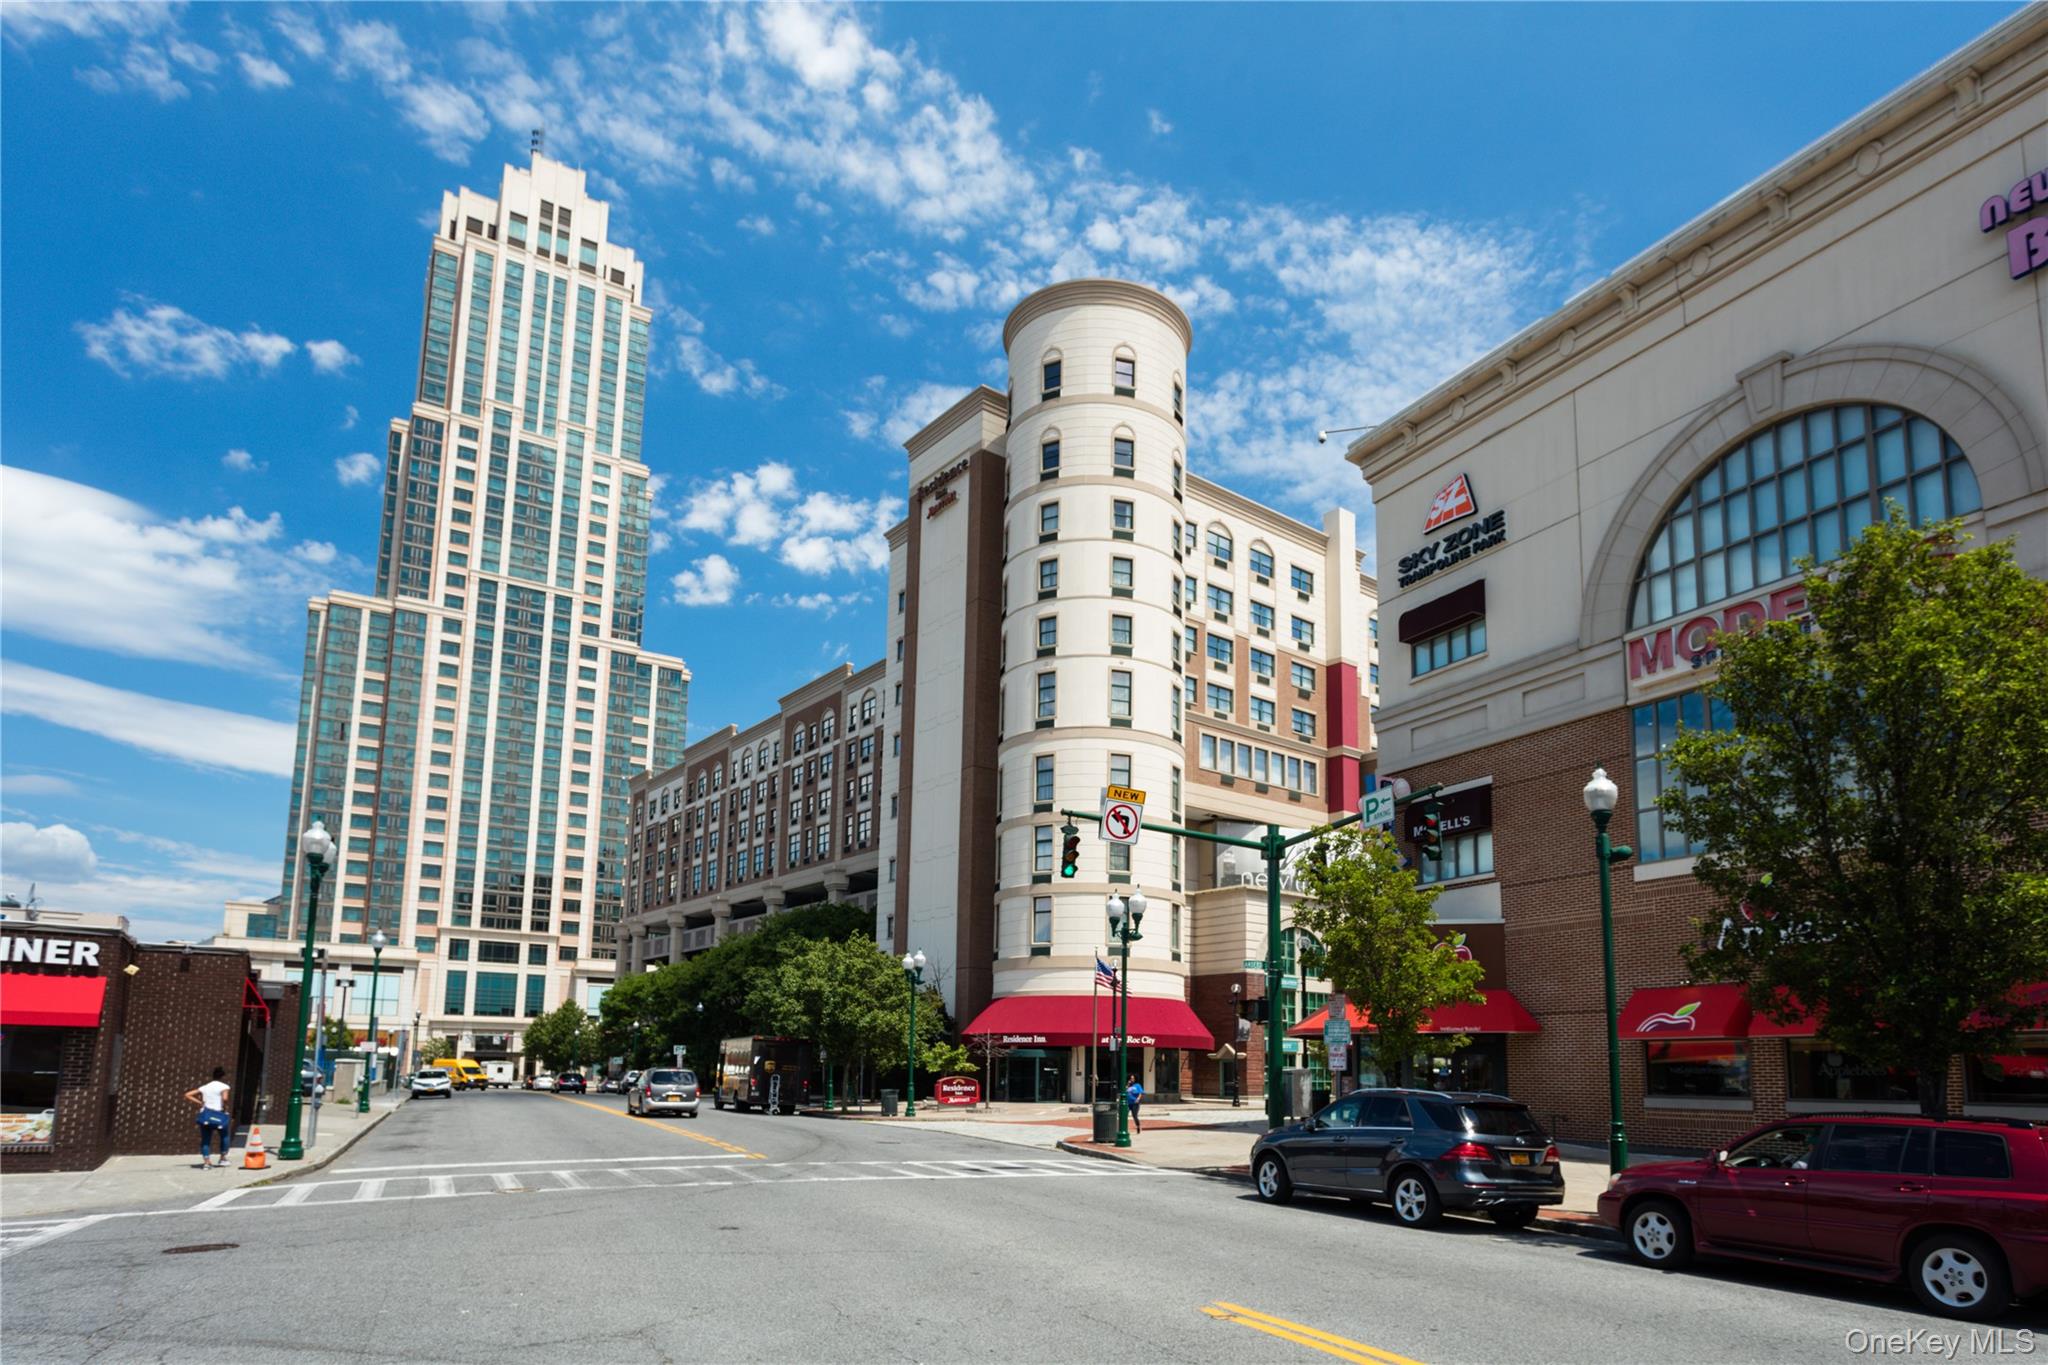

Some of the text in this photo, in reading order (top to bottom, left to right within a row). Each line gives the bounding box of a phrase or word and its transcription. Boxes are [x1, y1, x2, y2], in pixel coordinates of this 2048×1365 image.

[1398, 509, 1506, 574] SKY ZONE
[1398, 529, 1506, 588] TRAMPOLINE PARK
[1113, 789, 1140, 801] NEW
[1413, 815, 1471, 838] MELL'S
[1003, 1034, 1047, 1044] Residence Inn
[1126, 1035, 1141, 1043] Roc
[1141, 1035, 1156, 1046] City
[942, 1084, 976, 1092] Residence
